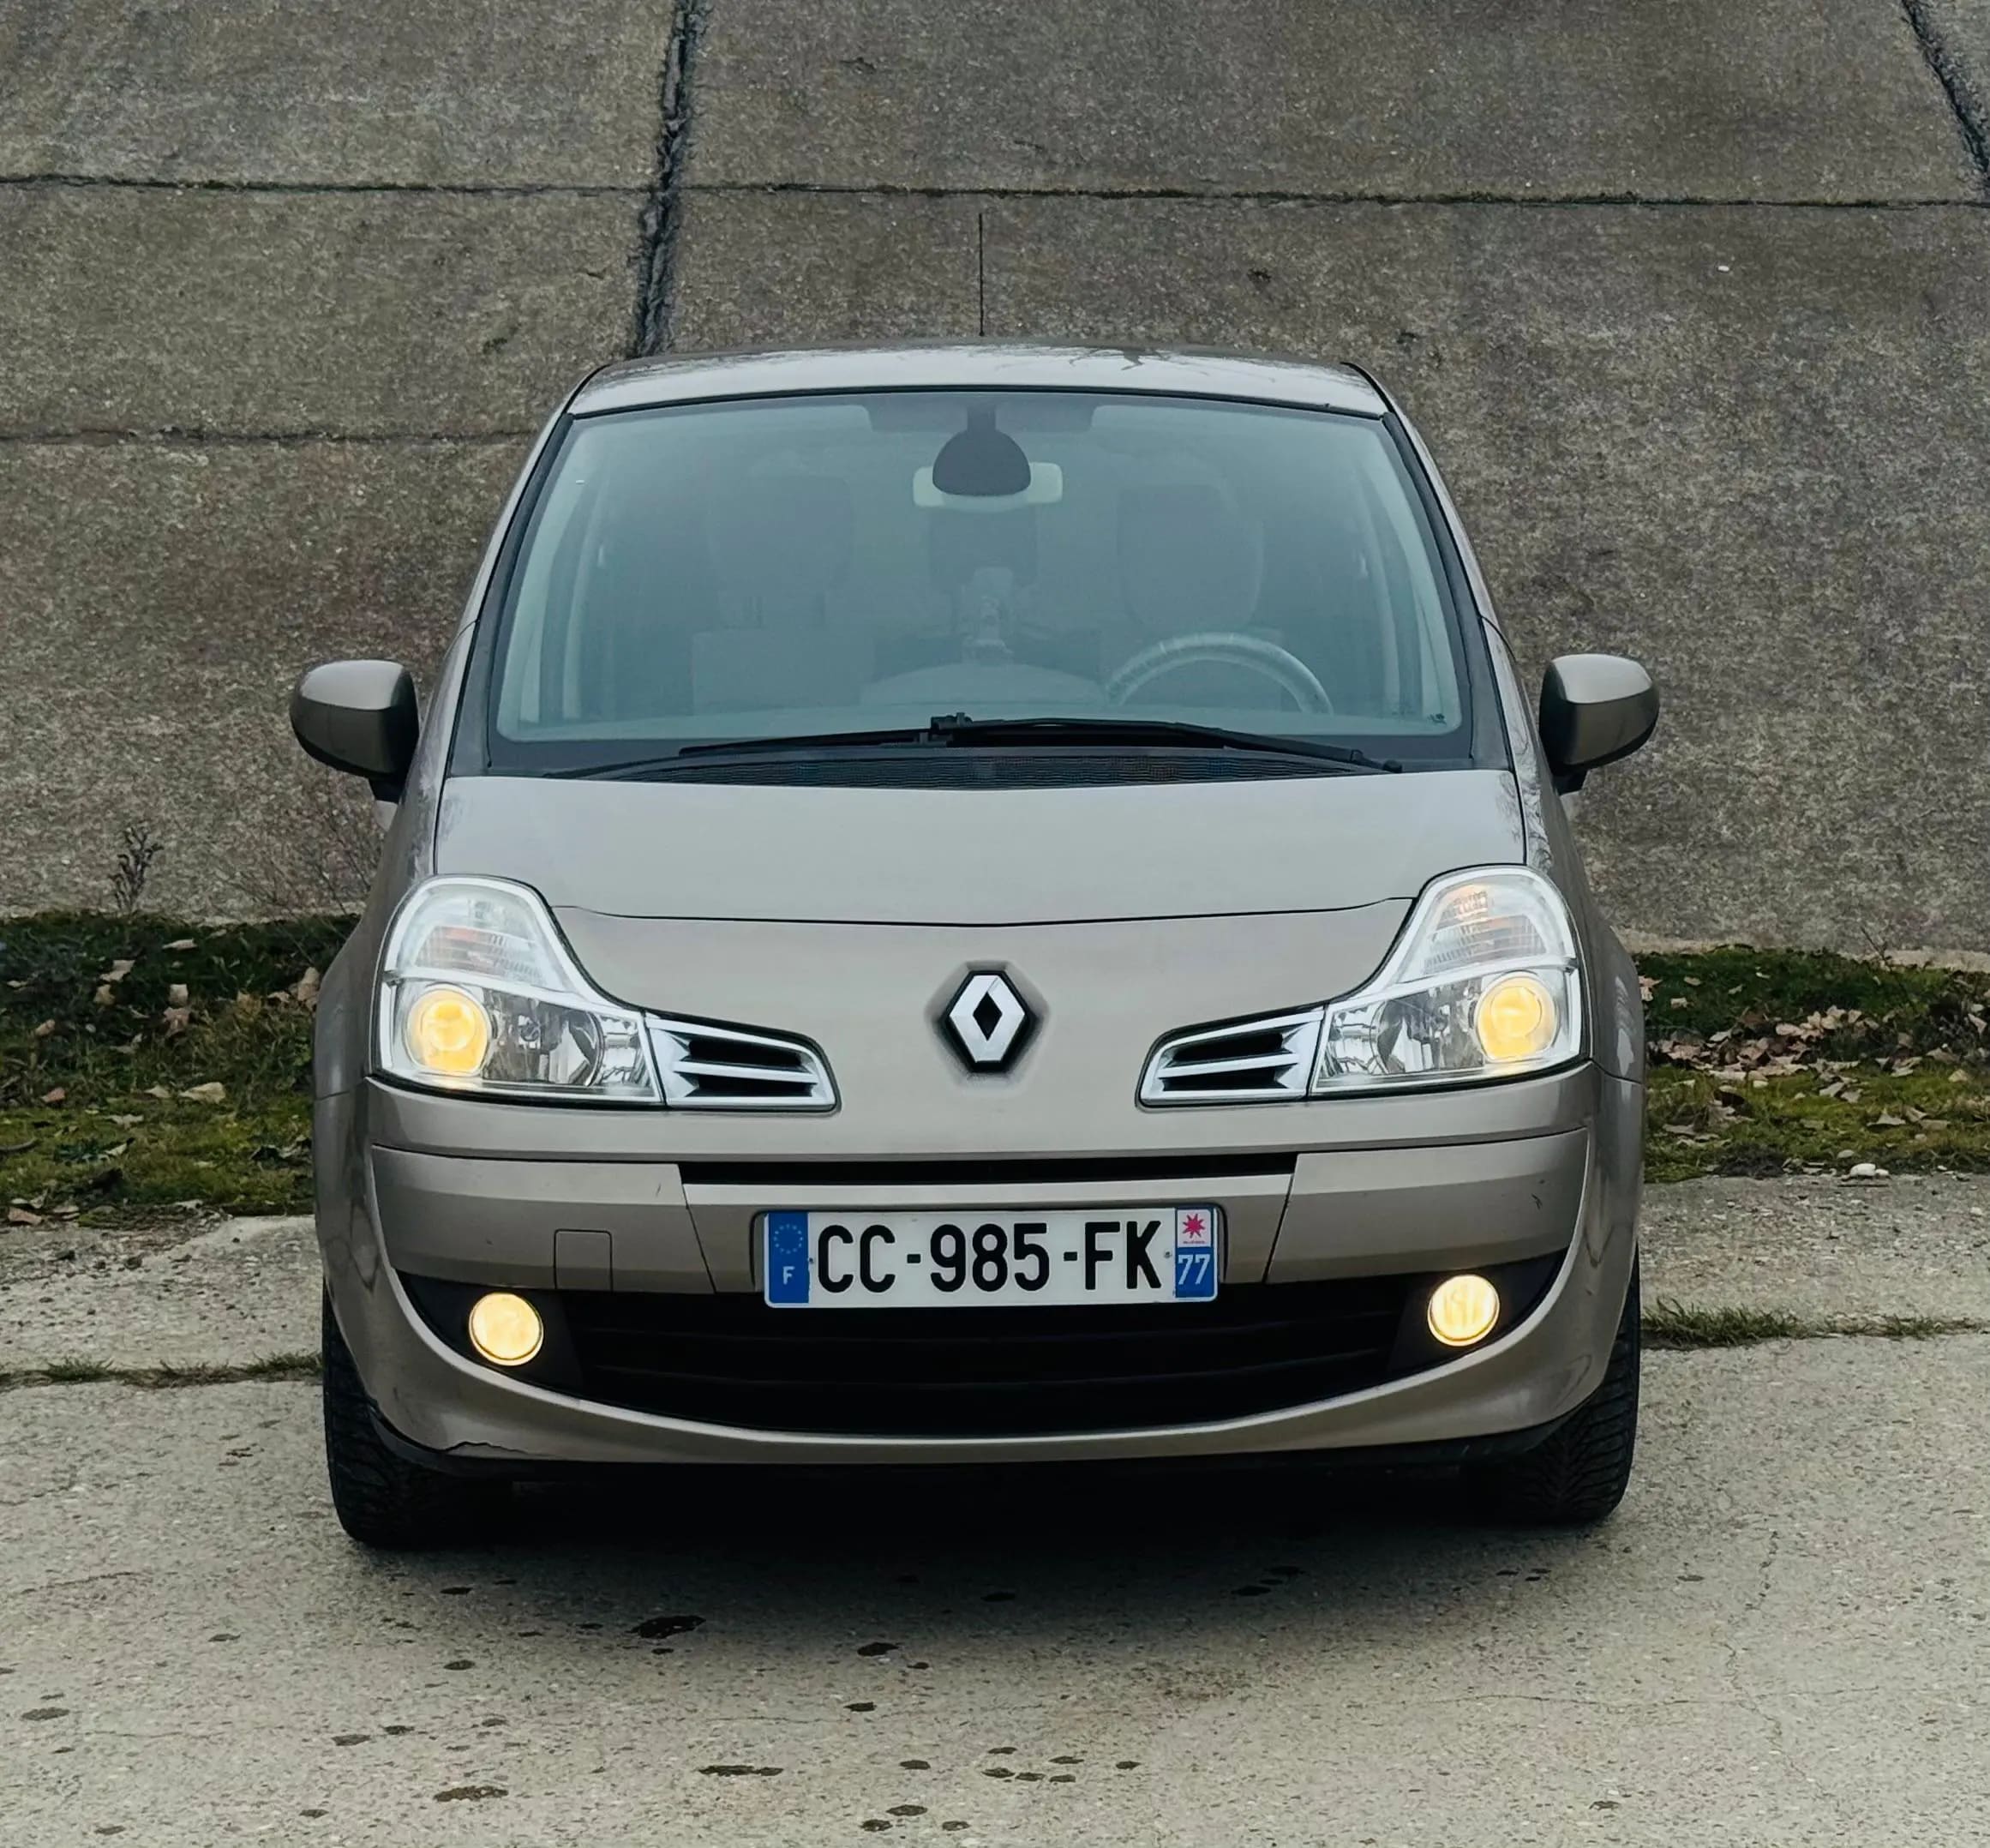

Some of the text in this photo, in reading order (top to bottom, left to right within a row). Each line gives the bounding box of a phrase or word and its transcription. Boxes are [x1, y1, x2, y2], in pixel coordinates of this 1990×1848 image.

[817, 1221, 1162, 1293] CC-985-FK
[1178, 1253, 1211, 1285] 77
[782, 1266, 795, 1285] F
